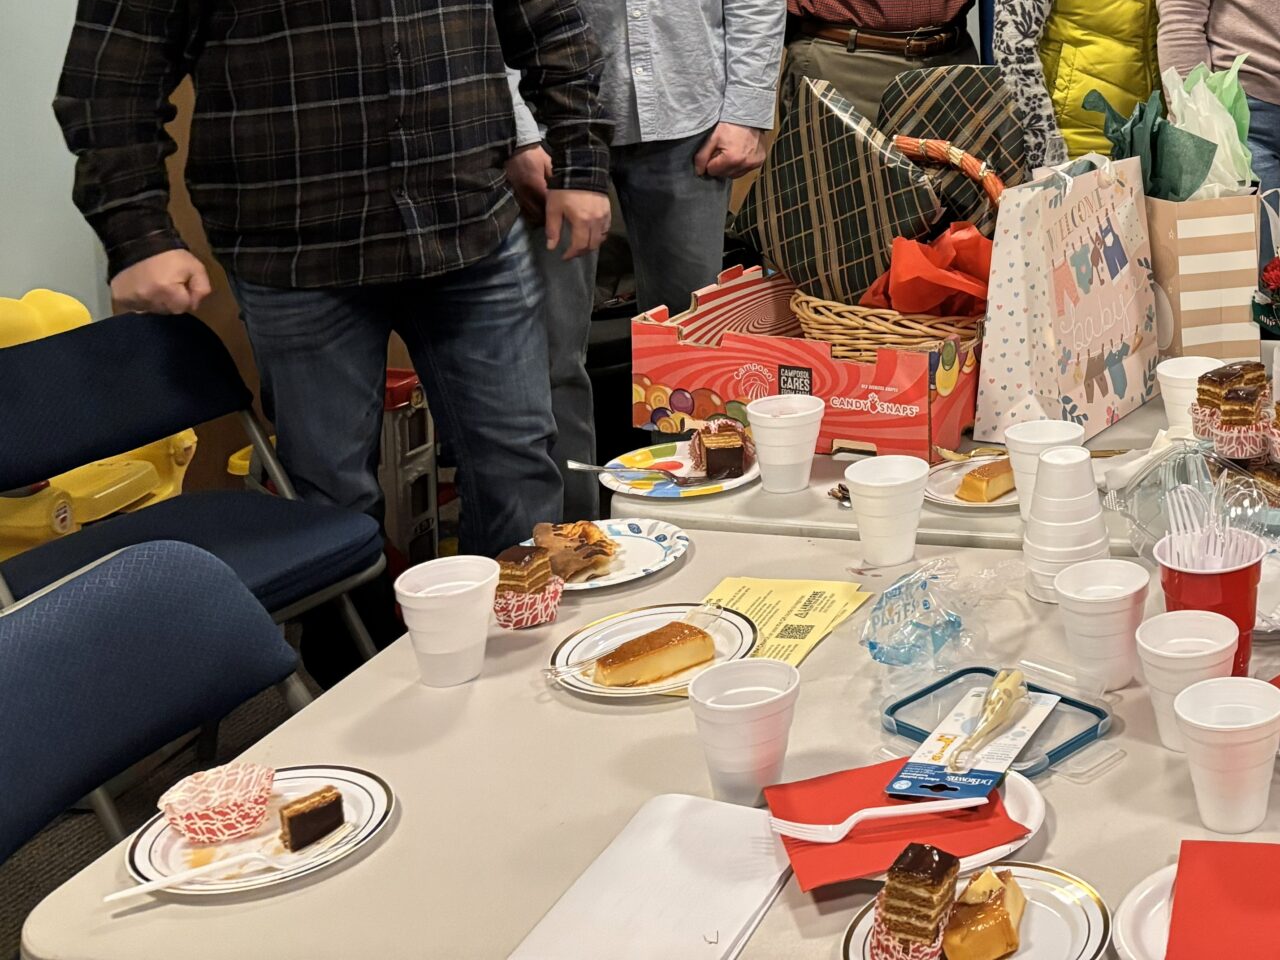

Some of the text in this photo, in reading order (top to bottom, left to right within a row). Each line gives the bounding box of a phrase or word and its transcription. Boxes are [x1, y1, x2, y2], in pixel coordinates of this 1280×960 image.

[1046, 187, 1106, 251] WELCOME
[1060, 273, 1146, 350] baby
[733, 362, 776, 382] Camposol
[780, 368, 810, 379] CAMPOSOL
[780, 376, 810, 391] CARES
[830, 396, 917, 417] CANDY SNAPS
